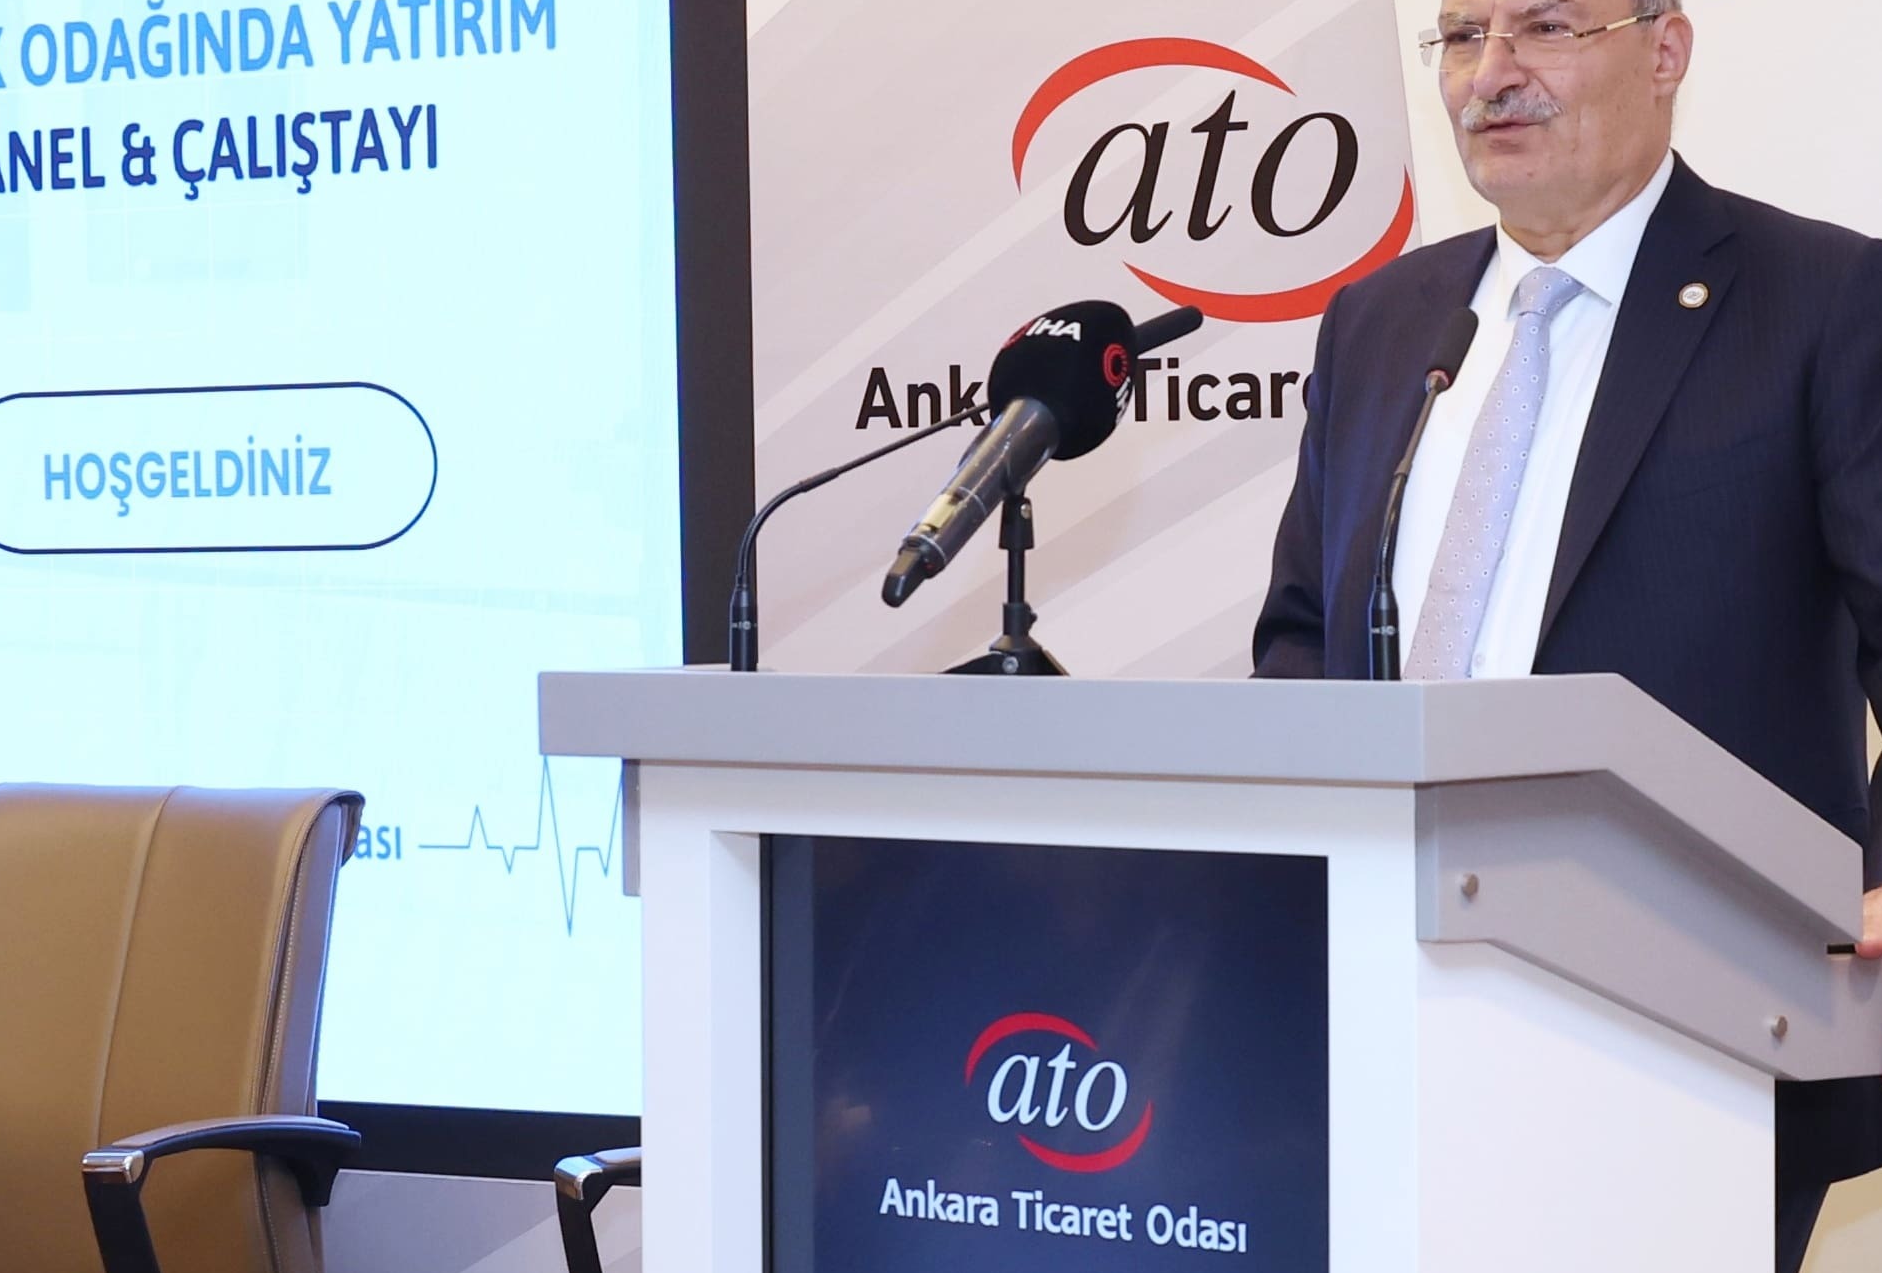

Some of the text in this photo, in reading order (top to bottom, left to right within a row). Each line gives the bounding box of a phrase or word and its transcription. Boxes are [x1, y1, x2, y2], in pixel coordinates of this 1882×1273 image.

[122, 123, 157, 186] &
[173, 104, 437, 201] ÇALIŞTAYI
[1064, 89, 1359, 247] ato
[855, 365, 991, 429] Ank
[1131, 357, 1309, 422] Ticar
[44, 434, 331, 517] HOŞGELDİNİZ
[987, 1043, 1128, 1132] ato
[880, 1179, 1246, 1252] Ankara Ticaret Odası
